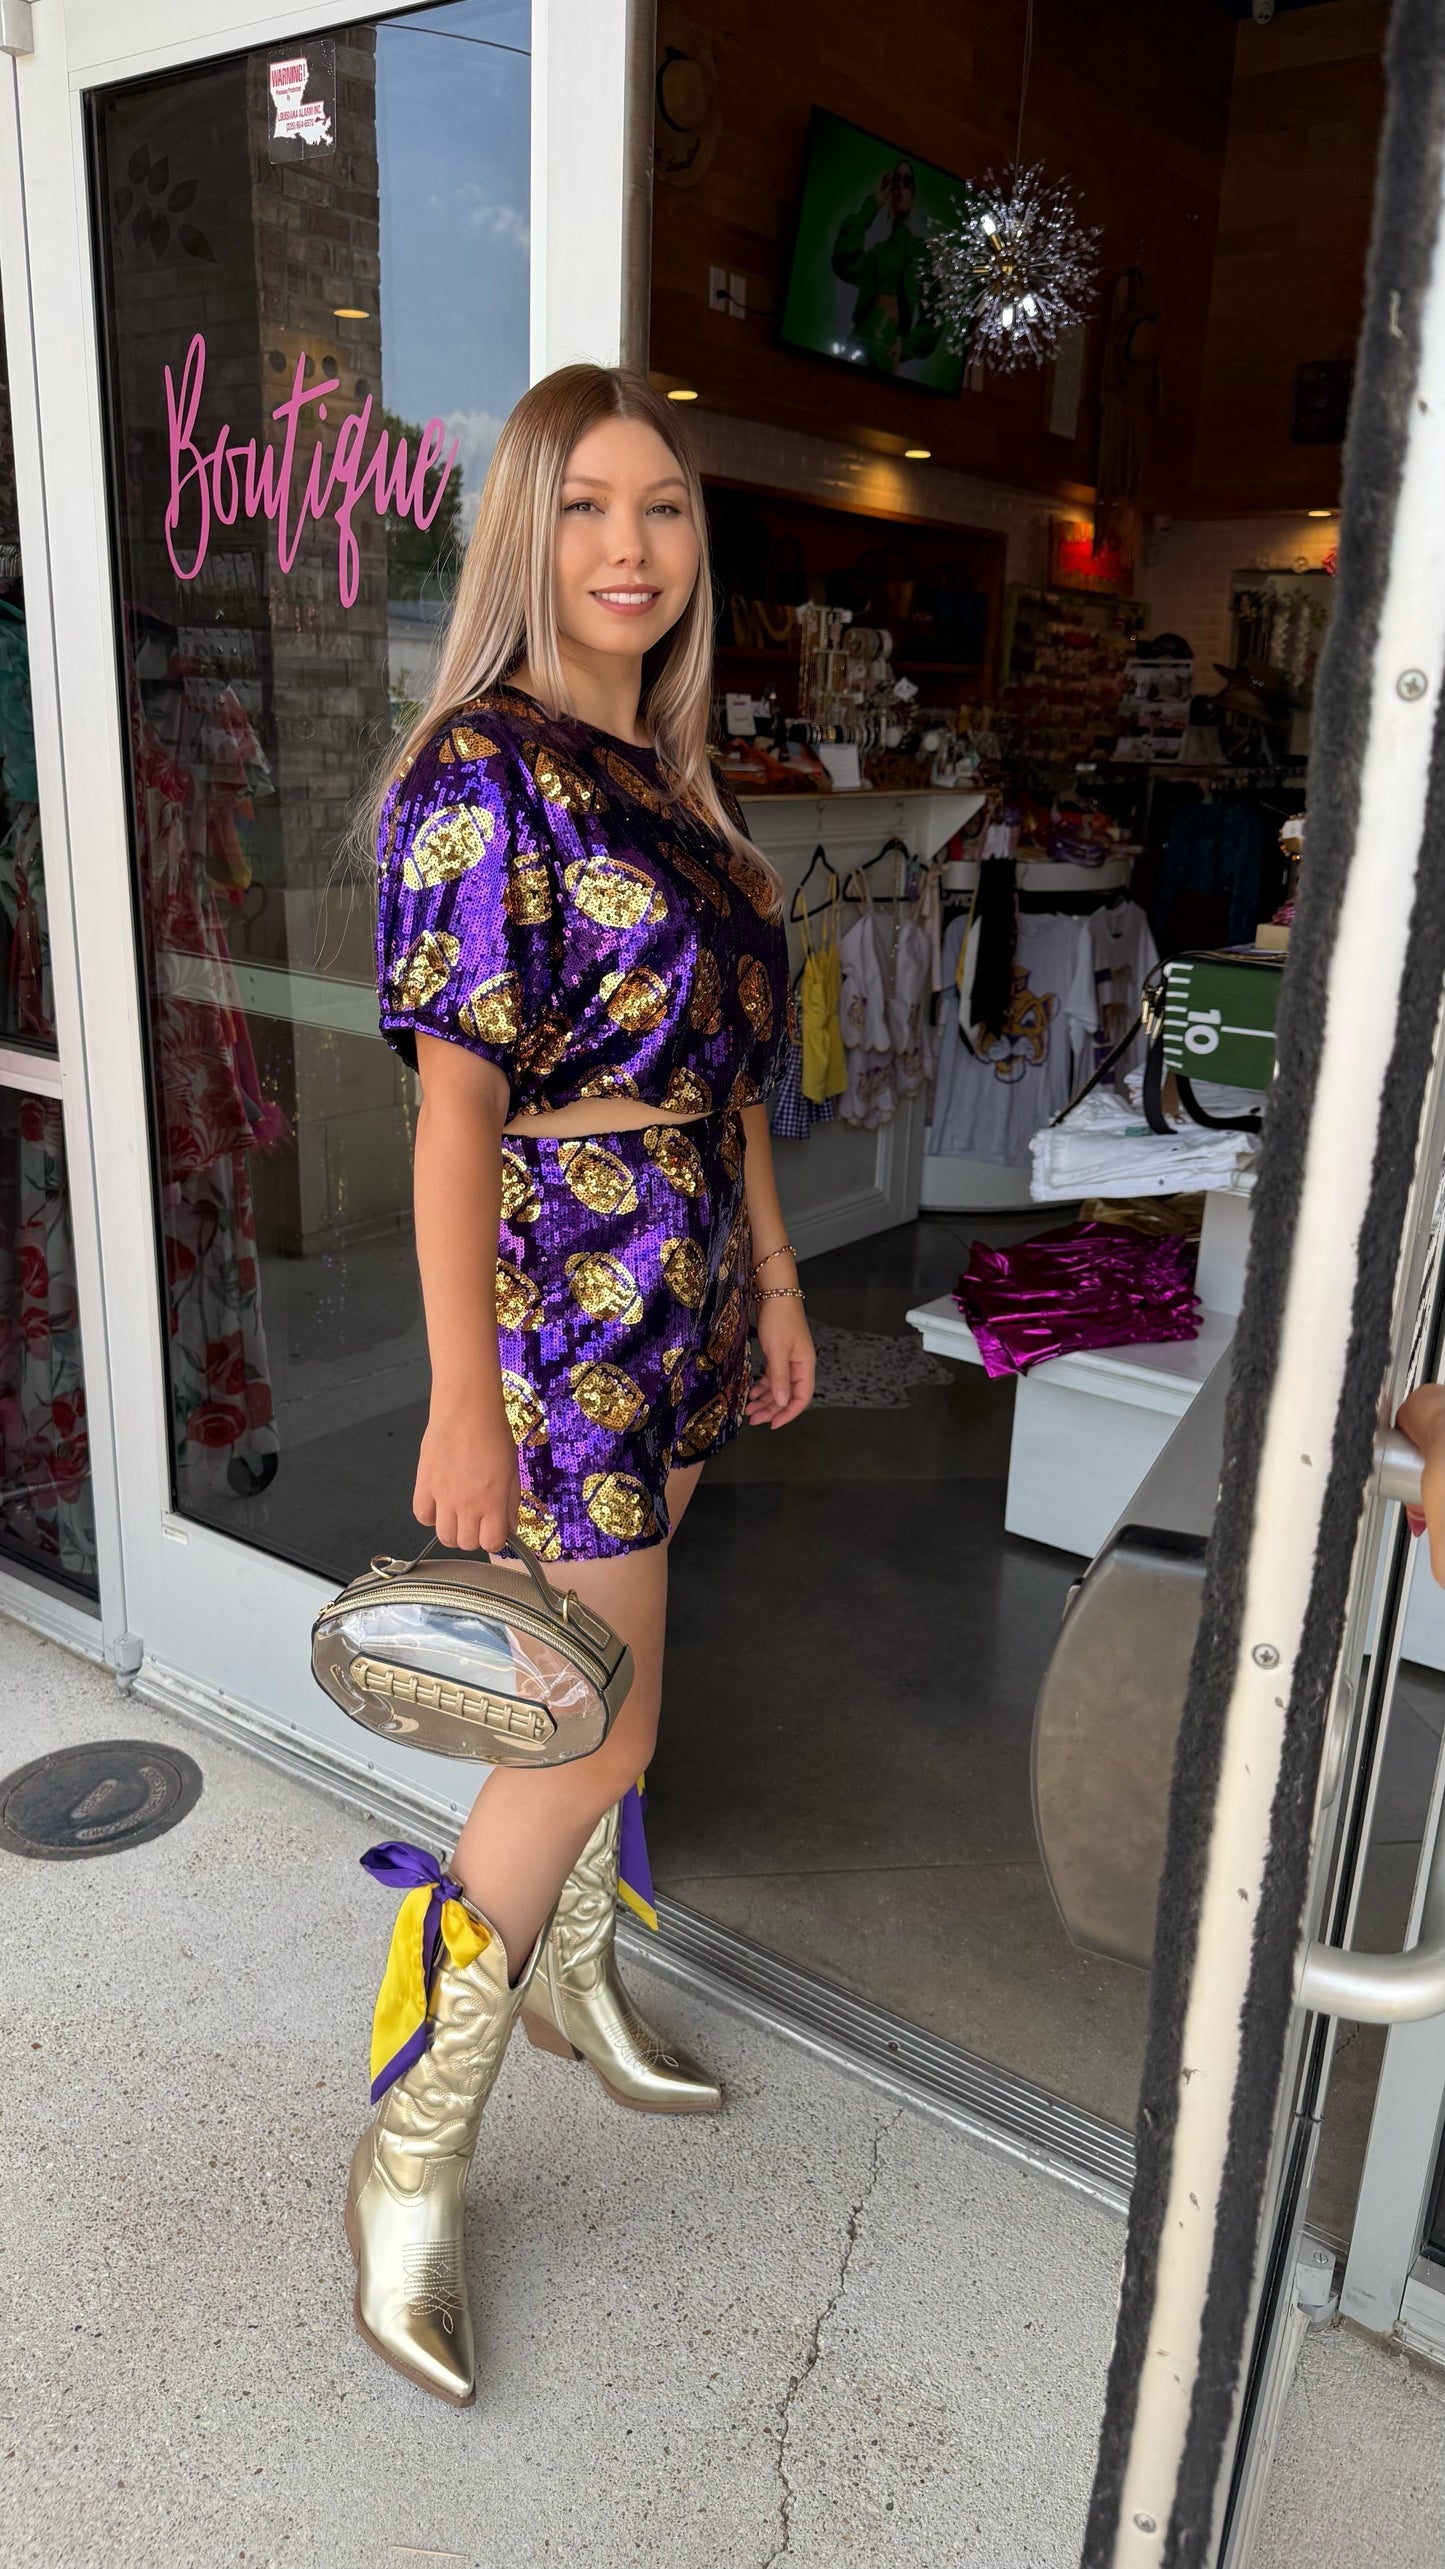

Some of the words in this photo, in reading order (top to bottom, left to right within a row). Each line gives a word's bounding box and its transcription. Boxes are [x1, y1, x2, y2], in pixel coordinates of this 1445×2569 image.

[272, 63, 306, 87] WARNING!
[278, 110, 298, 121] LOUISIANA
[299, 107, 313, 117] ALARM
[164, 333, 460, 609] Boutique
[1184, 1009, 1222, 1055] 10
